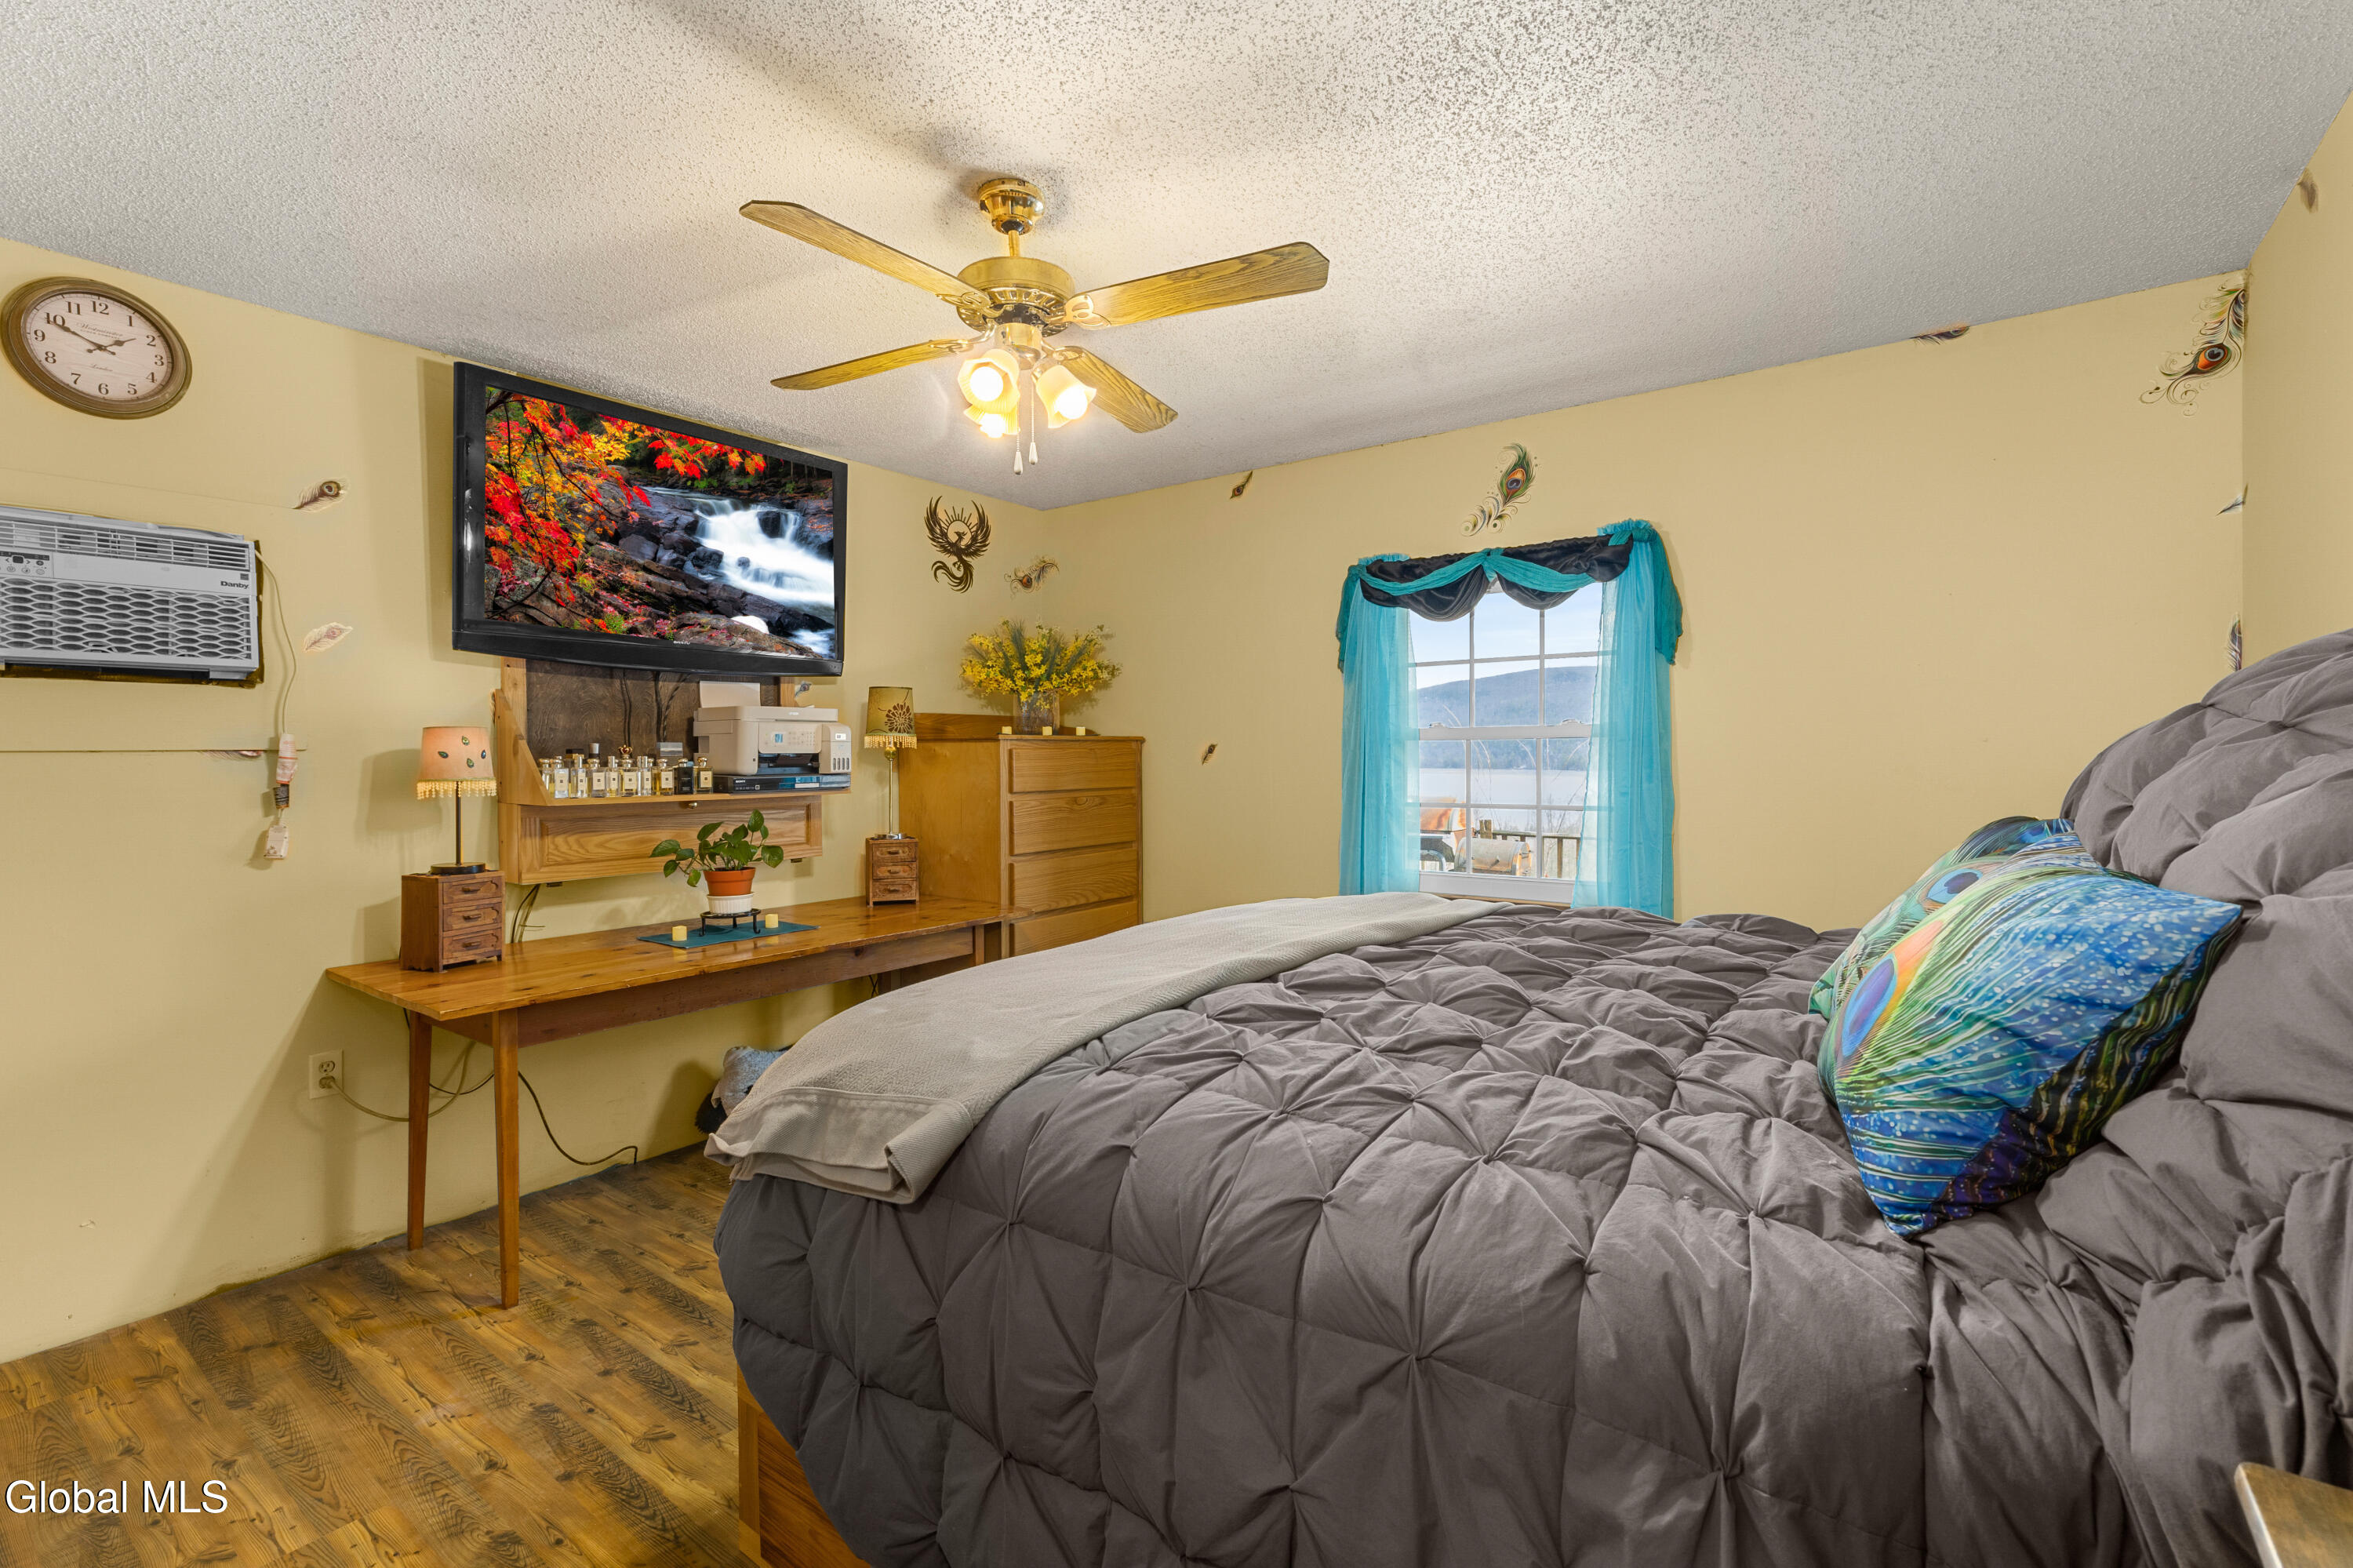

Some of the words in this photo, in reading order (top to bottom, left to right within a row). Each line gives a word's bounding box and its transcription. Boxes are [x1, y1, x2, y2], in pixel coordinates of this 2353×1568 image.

[65, 301, 82, 315] 11
[90, 300, 109, 315] 12
[45, 312, 65, 327] 10
[127, 315, 134, 327] 1
[34, 329, 45, 342] 9
[146, 335, 157, 347] 2
[45, 351, 56, 364] 8
[155, 355, 165, 366] 3
[71, 373, 81, 385] 7
[146, 372, 157, 383] 4
[98, 383, 109, 395] 6
[127, 383, 137, 395] 5
[220, 580, 249, 589] Danby
